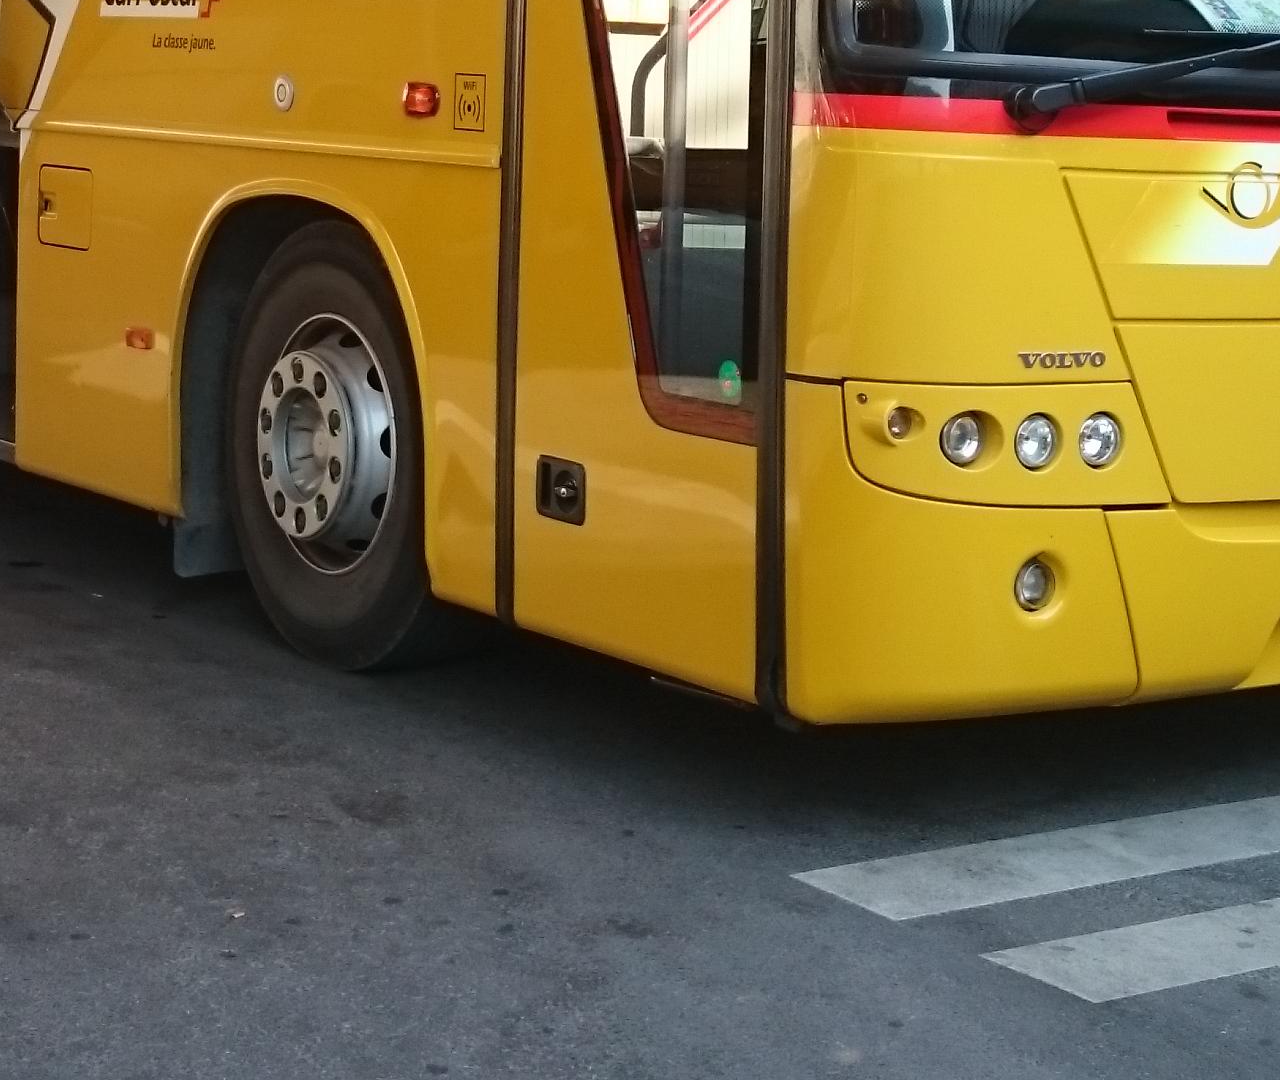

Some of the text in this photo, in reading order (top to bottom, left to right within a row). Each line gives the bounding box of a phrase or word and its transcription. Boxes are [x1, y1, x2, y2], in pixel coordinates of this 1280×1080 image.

[152, 32, 216, 54] La classe jaune.
[463, 81, 477, 91] WiFi
[1017, 352, 1106, 368] VOLVO
